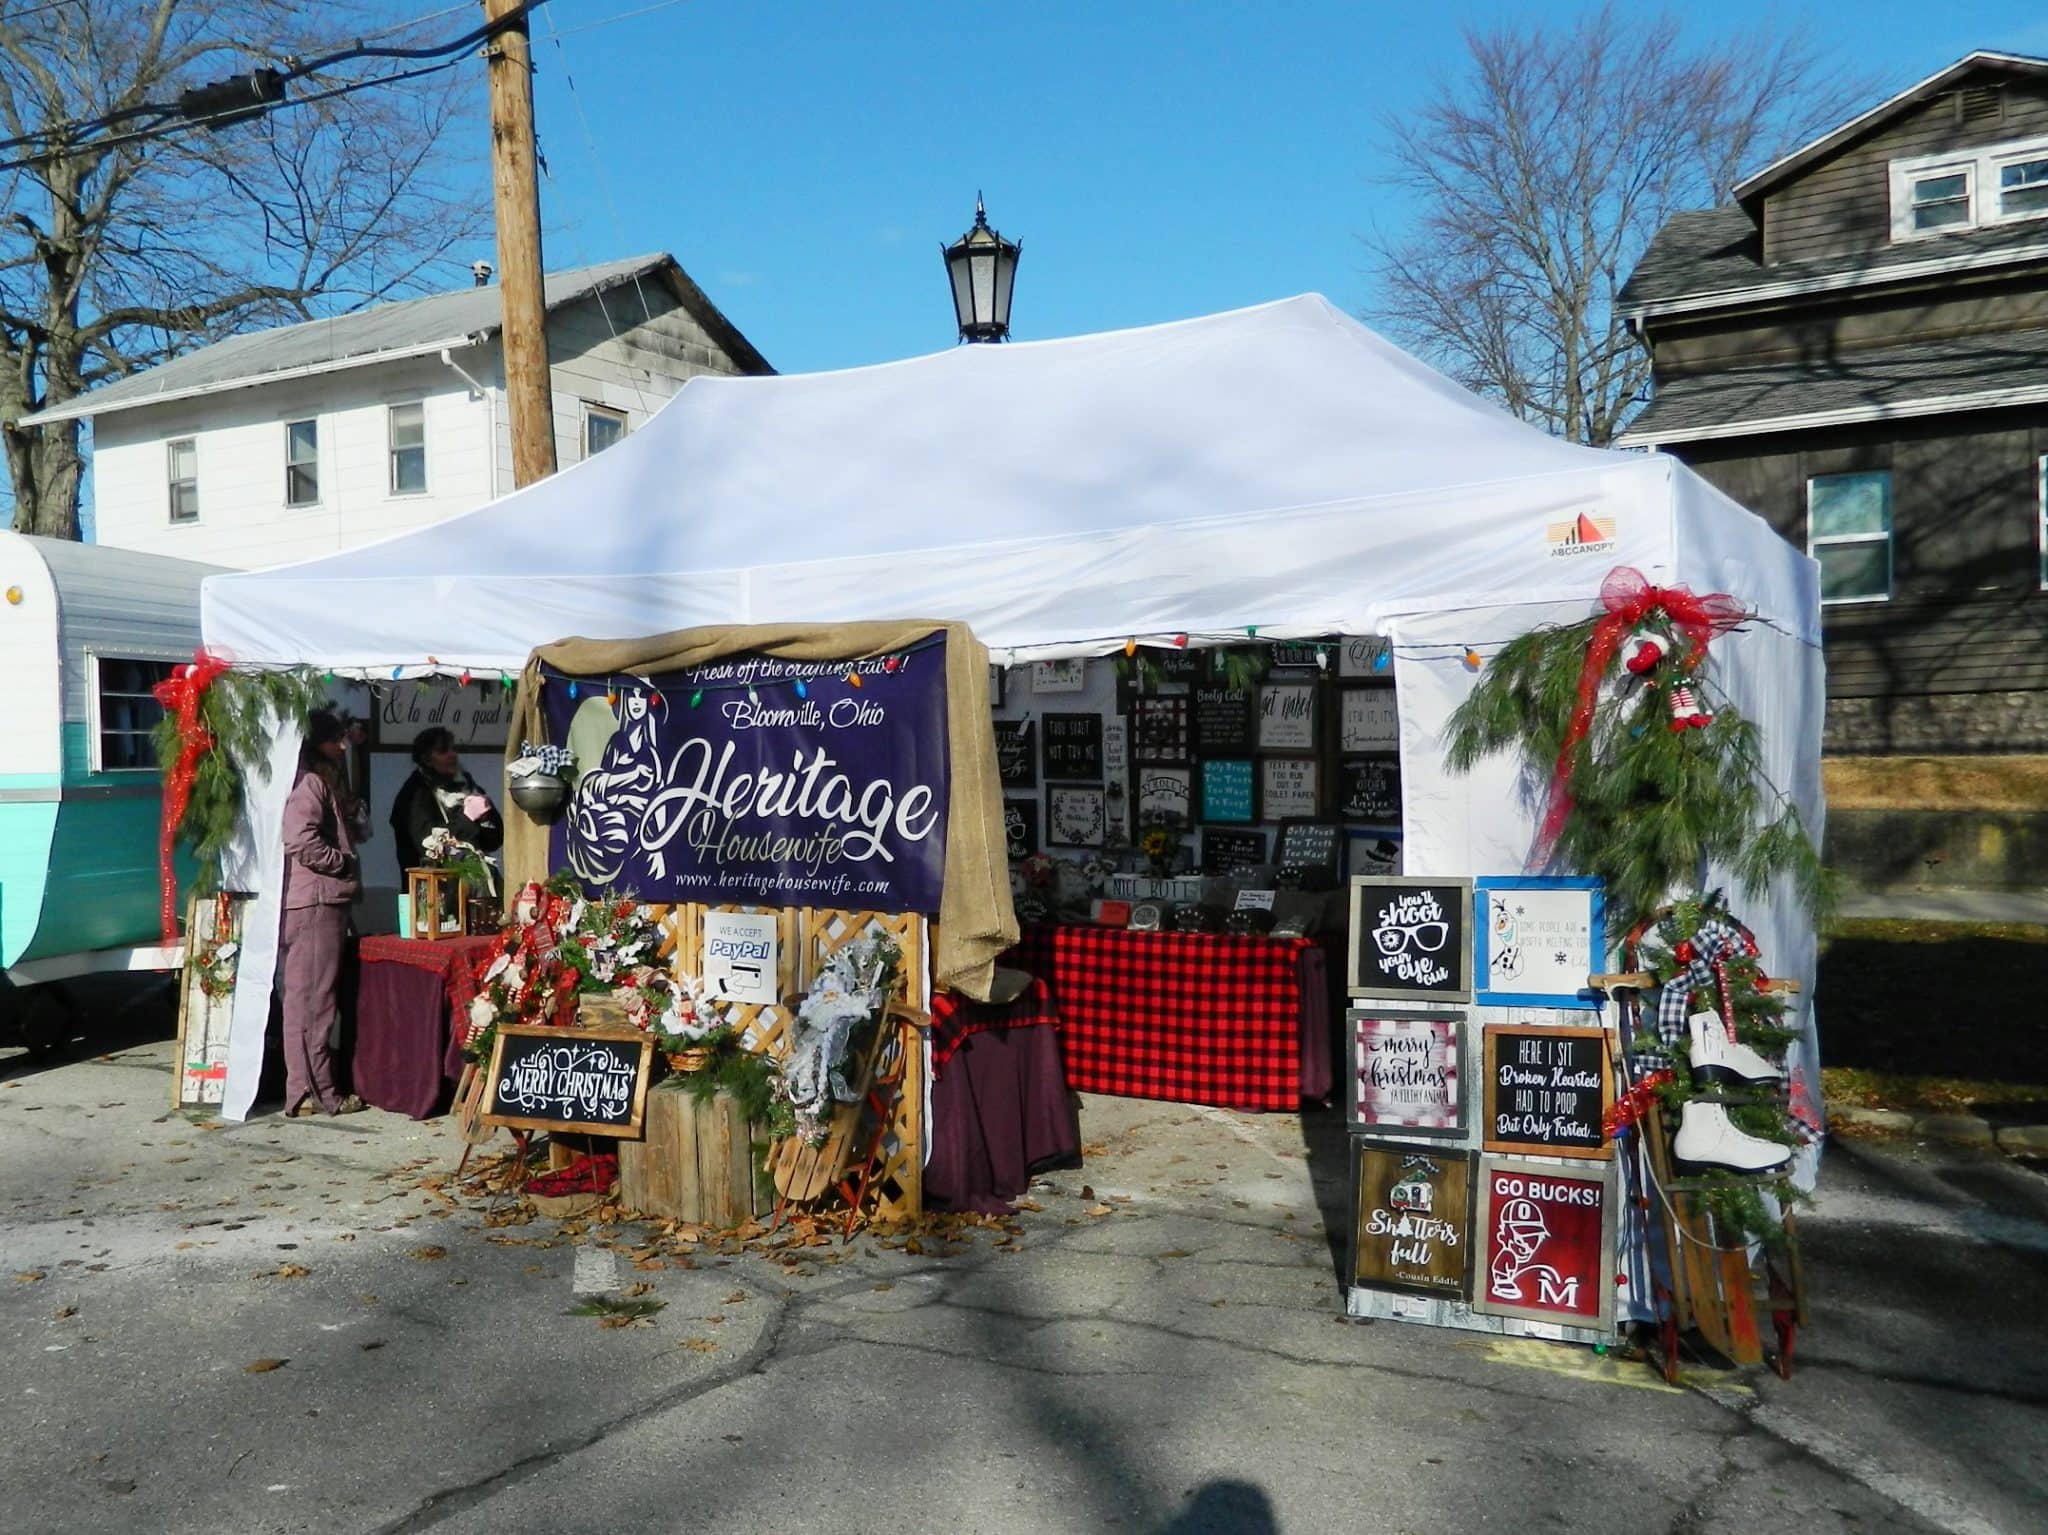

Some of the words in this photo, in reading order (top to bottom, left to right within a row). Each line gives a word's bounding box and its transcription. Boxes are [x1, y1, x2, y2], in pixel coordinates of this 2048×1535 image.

[1551, 542, 1615, 557] ABCCANOPY
[736, 657, 760, 685] off
[759, 658, 783, 677] the
[428, 687, 450, 724] all
[722, 700, 826, 731] Bloomville,
[829, 698, 885, 729] Ohio
[640, 738, 939, 863] Heritage
[687, 806, 844, 876] Housewife
[674, 871, 891, 896] www.heritagehousewife.com
[1113, 879, 1136, 897] NICE
[1399, 890, 1435, 911] you'll
[1379, 902, 1443, 927] shoot
[720, 925, 732, 936] WE
[733, 927, 763, 938] ACCEPT
[710, 938, 770, 960] PayPal
[1379, 953, 1412, 974] your
[1397, 957, 1433, 984] eye
[1423, 966, 1449, 986] out
[1369, 1029, 1436, 1069] merry
[1519, 1040, 1542, 1064] HERE
[1557, 1042, 1573, 1066] SIT
[509, 1056, 555, 1101] MERRY
[555, 1060, 630, 1104] CHRISTMAS
[1361, 1057, 1457, 1090] christmas
[1500, 1065, 1547, 1086] Broken
[1550, 1067, 1600, 1088] Hearted
[1516, 1089, 1533, 1113] HAD
[1539, 1090, 1550, 1113] TO
[1555, 1091, 1577, 1115] POOP
[1497, 1113, 1520, 1134] But
[1523, 1114, 1552, 1141] Only
[1495, 1178, 1522, 1196] GO
[1528, 1180, 1601, 1207] BUCKS!
[1366, 1208, 1460, 1246] Shtter's
[1390, 1239, 1432, 1265] full
[1432, 1275, 1459, 1286] Eddie
[1537, 1276, 1578, 1308] M
